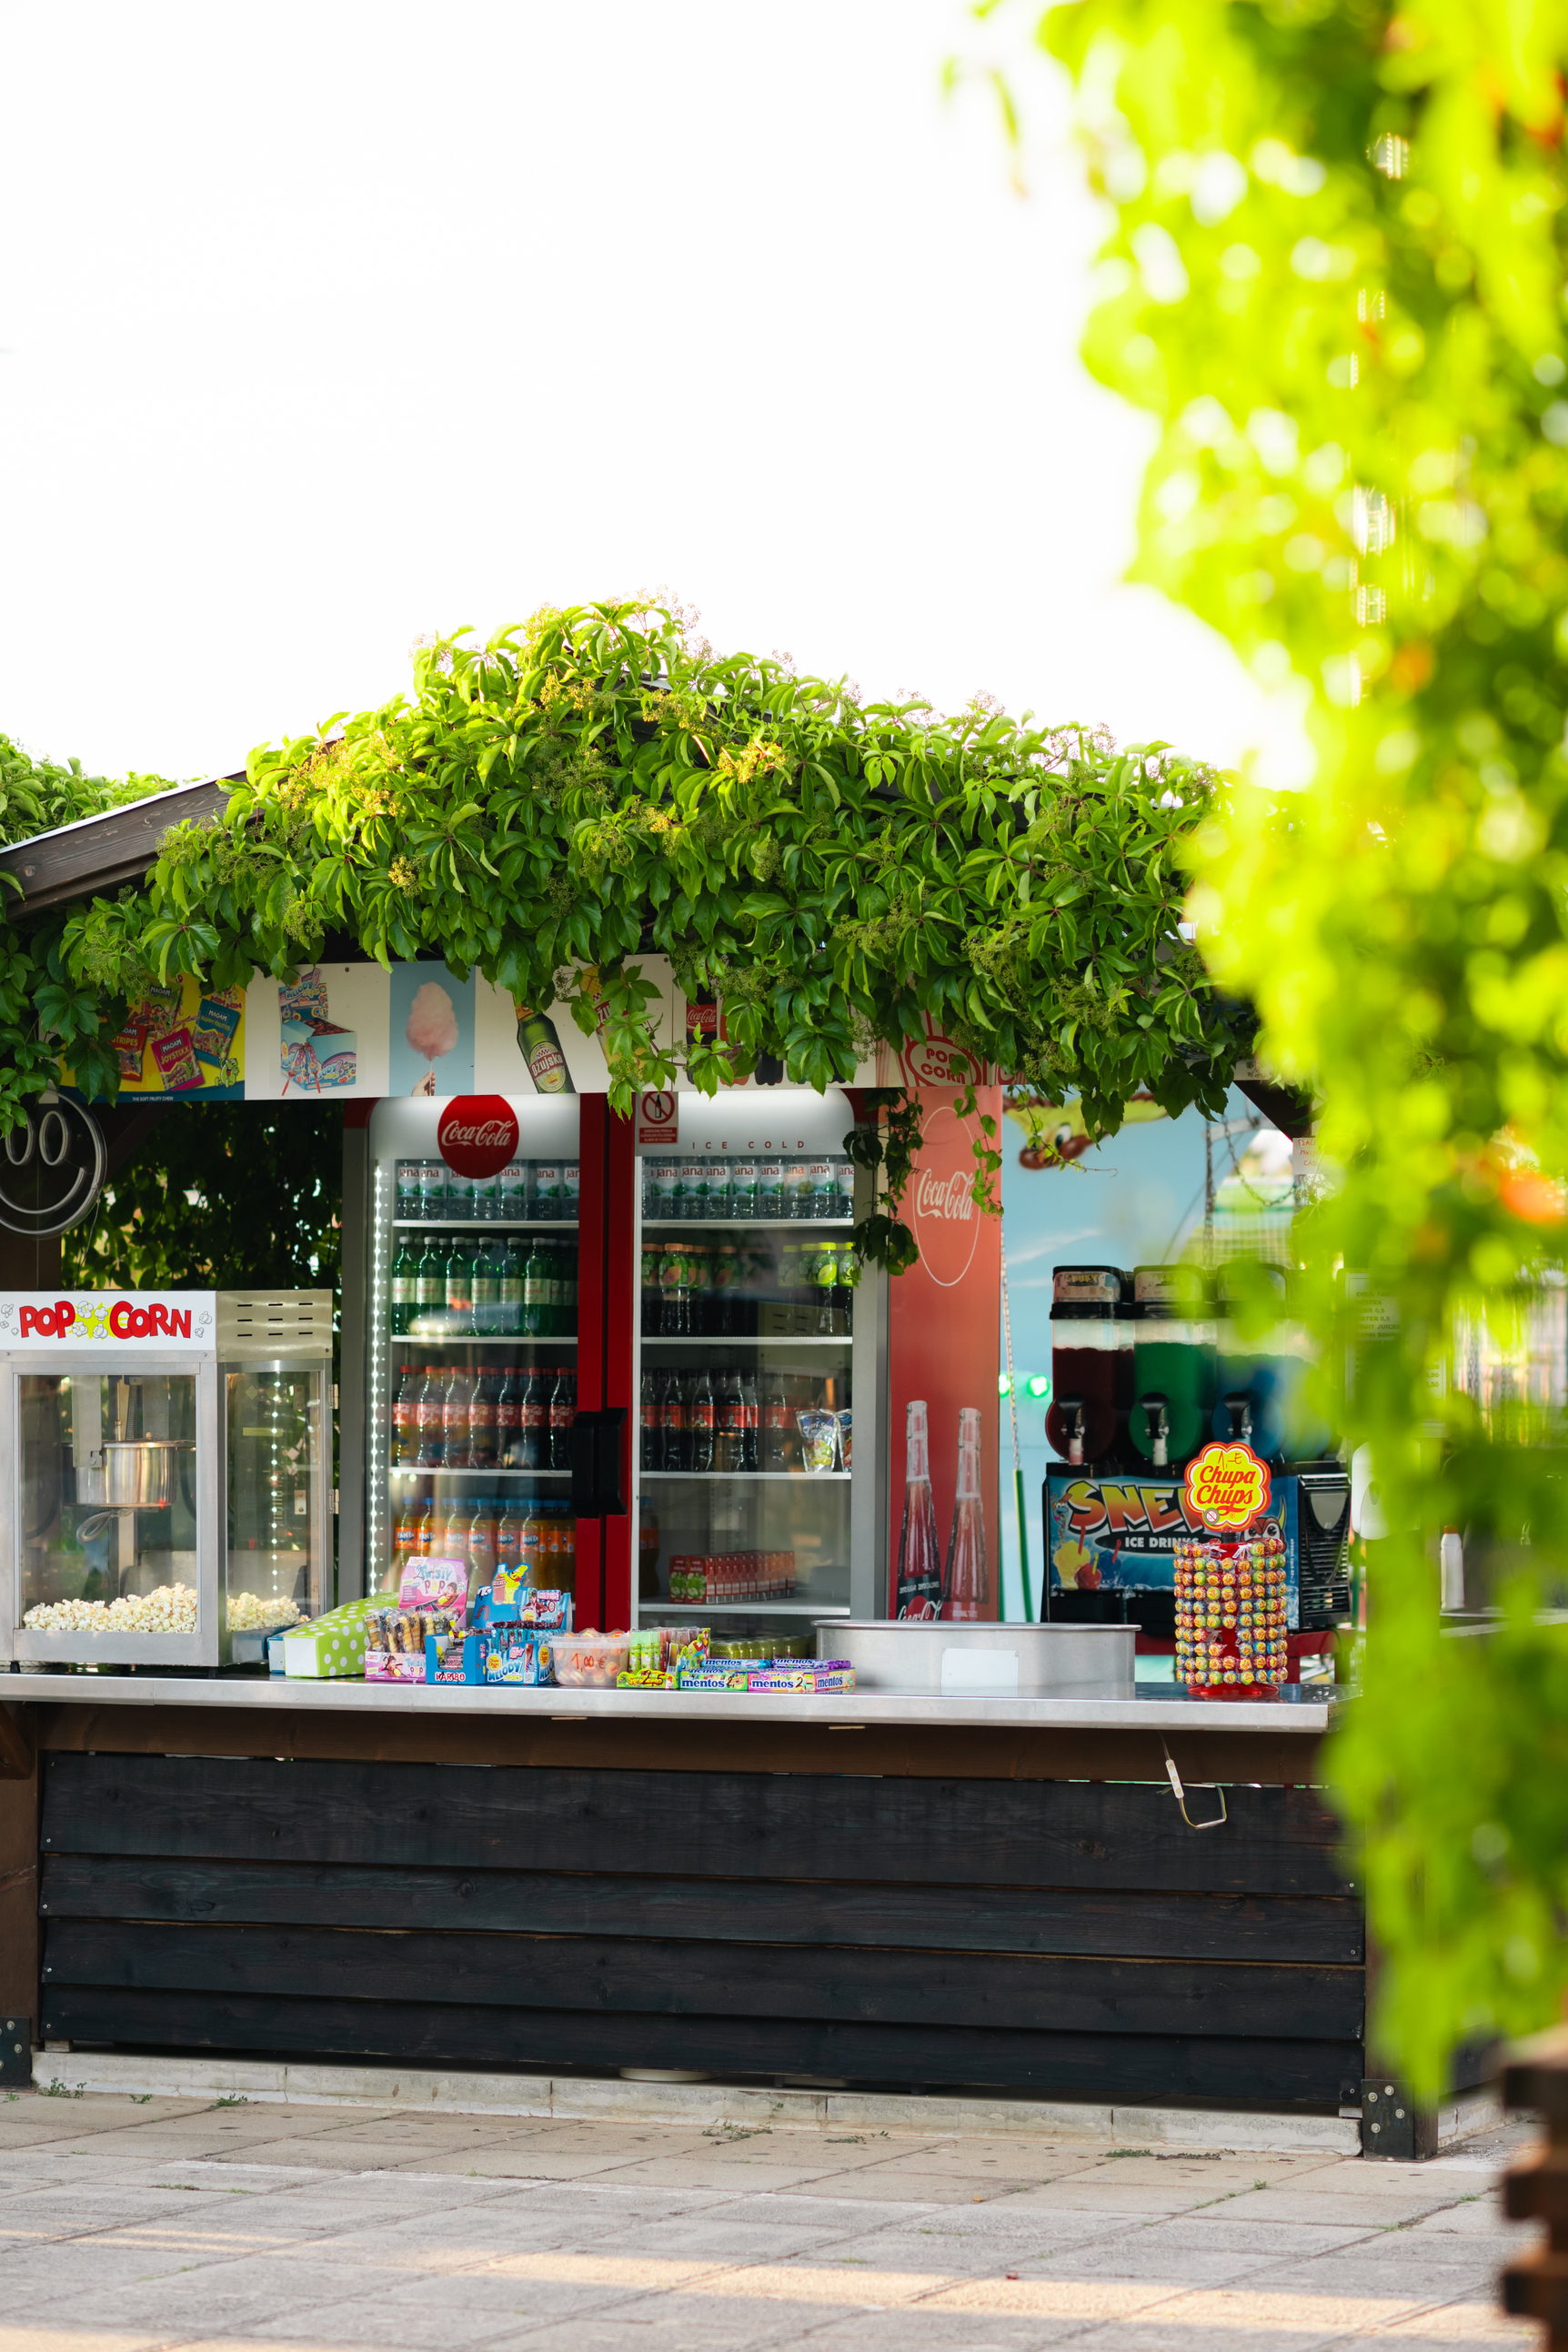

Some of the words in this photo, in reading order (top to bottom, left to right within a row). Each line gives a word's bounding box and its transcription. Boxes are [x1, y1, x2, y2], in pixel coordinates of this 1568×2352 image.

[150, 984, 171, 997] MAOAM
[286, 980, 313, 998] MELODY
[208, 1010, 227, 1021] MAOAM
[687, 1009, 717, 1024] Coca-Cola
[122, 1027, 137, 1036] OAM
[162, 1038, 182, 1053] MAOAM
[161, 1046, 189, 1064] JOYSTIXX
[441, 1120, 516, 1146] Coca-Cola
[692, 1141, 728, 1150] ICE
[748, 1141, 805, 1149] COLD
[917, 1168, 976, 1221] Coca-Cola
[19, 1301, 75, 1339] POP
[109, 1301, 192, 1339] CORN
[1199, 1465, 1257, 1489] Chupa
[1196, 1484, 1254, 1514] Chups
[1125, 1537, 1145, 1547] ICE
[598, 1655, 608, 1669] €
[487, 1661, 522, 1681] MELODY
[682, 1678, 725, 1689] mentos
[751, 1679, 794, 1689] mentos
[817, 1676, 843, 1688] mentos
